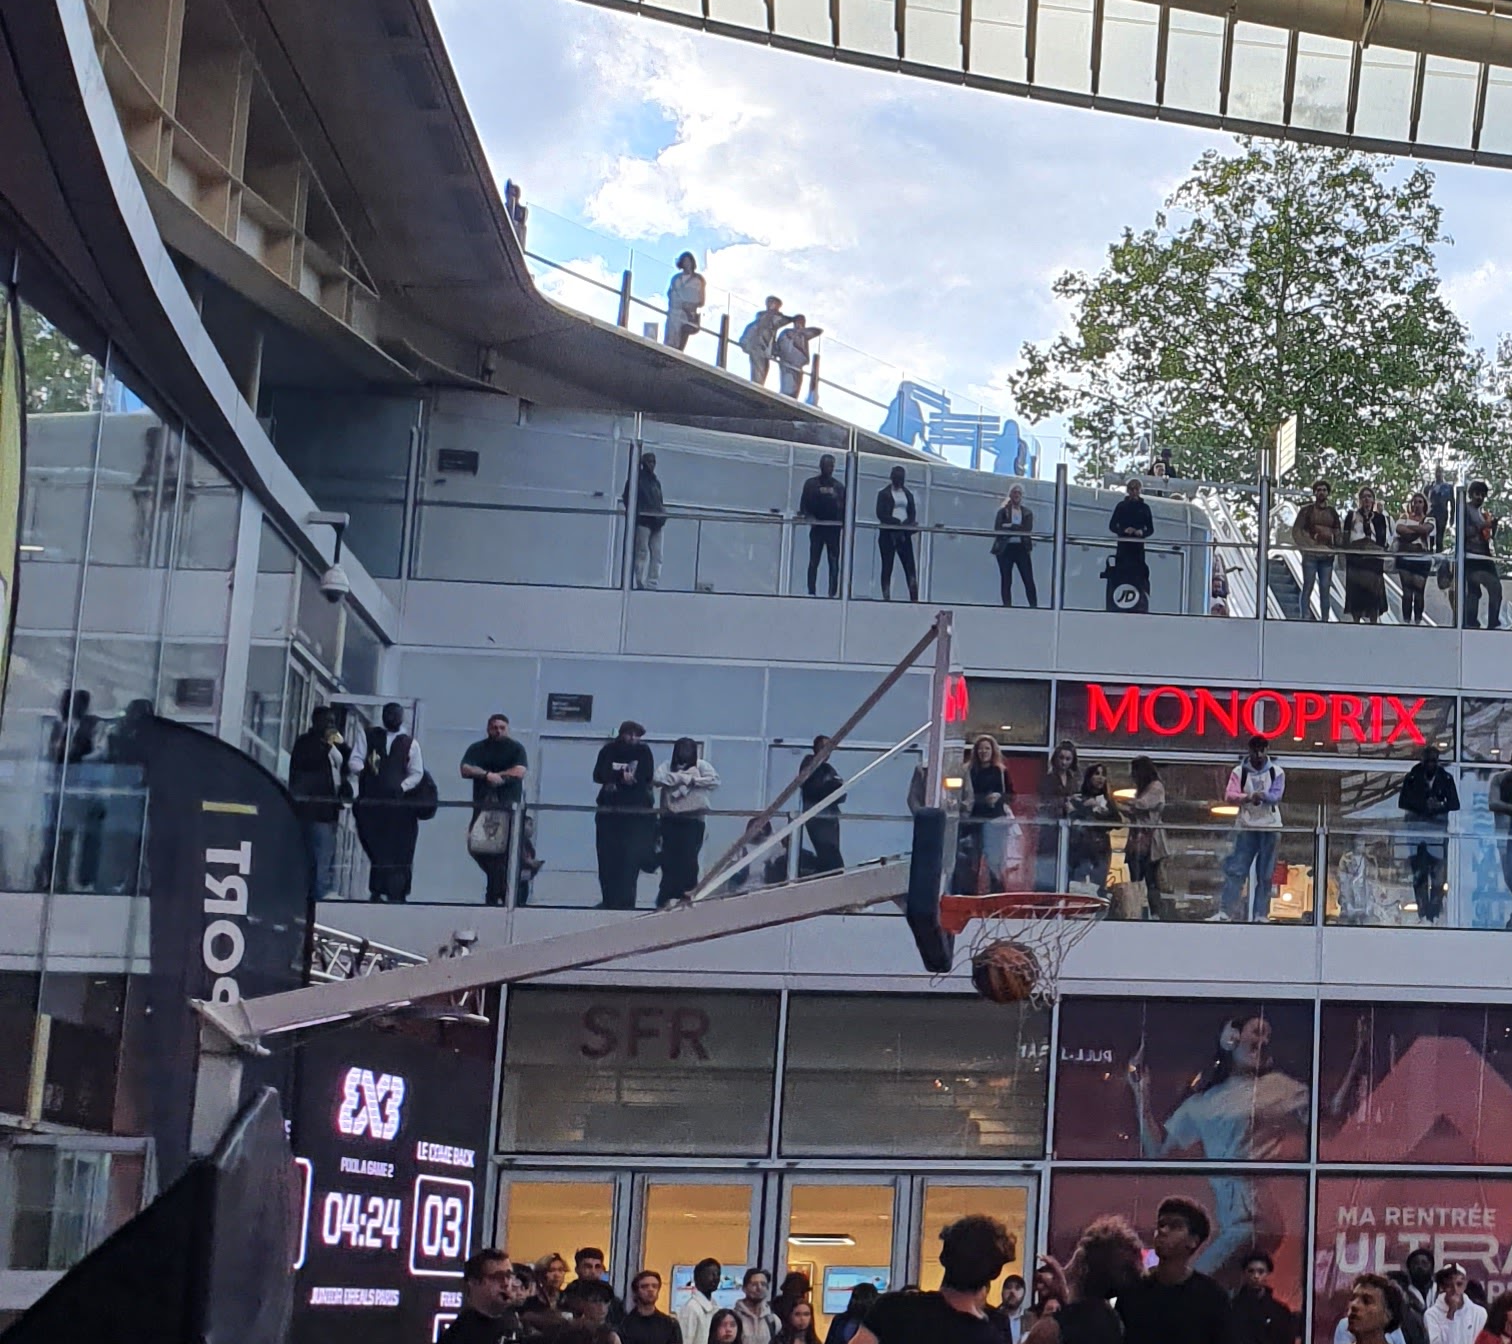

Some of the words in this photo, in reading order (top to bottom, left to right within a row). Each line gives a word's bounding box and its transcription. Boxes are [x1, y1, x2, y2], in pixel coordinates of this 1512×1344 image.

[1117, 590, 1137, 603] JD
[1087, 684, 1427, 746] MONOPRIX
[581, 1006, 711, 1060] SFR
[322, 1192, 401, 1249] 04:24
[422, 1194, 462, 1256] 03
[1338, 1207, 1375, 1226] MA
[1385, 1203, 1496, 1227] RENTRÉE
